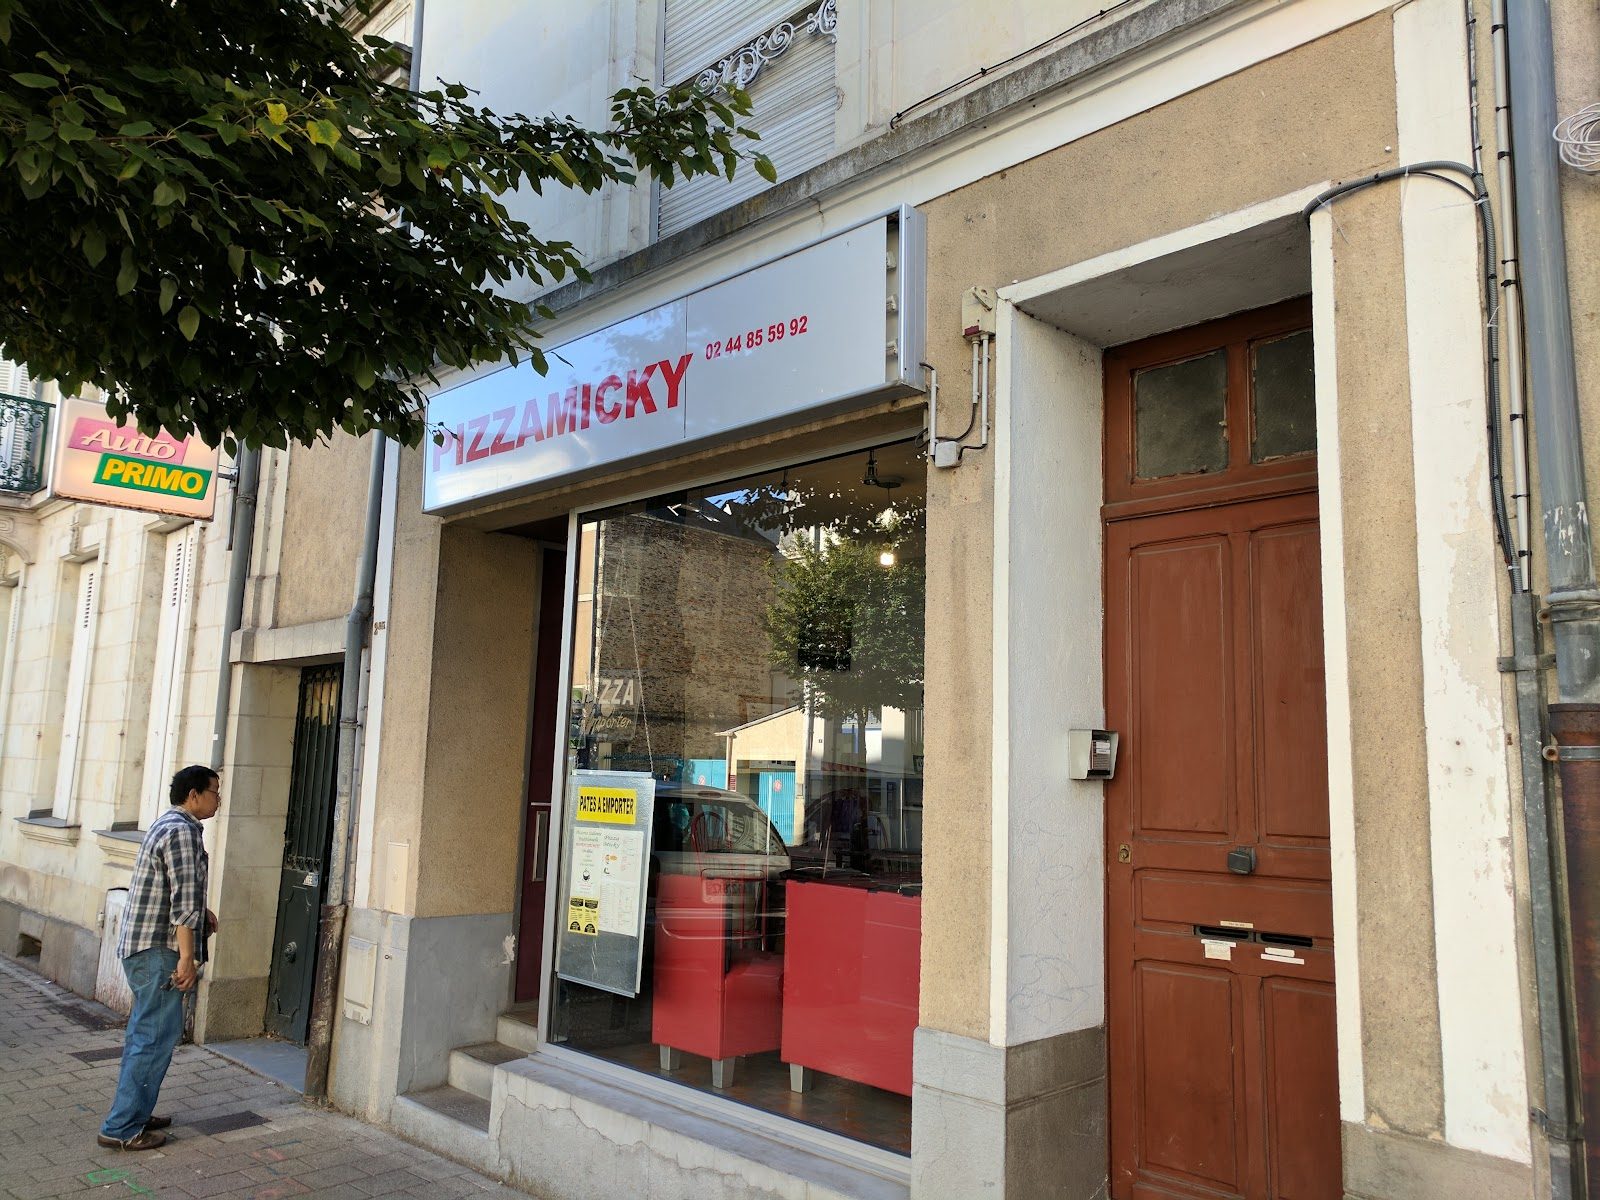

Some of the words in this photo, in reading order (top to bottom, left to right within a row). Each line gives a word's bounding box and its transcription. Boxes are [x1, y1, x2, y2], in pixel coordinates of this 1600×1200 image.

[705, 341, 721, 360] 02
[725, 335, 742, 354] 44
[746, 329, 763, 349] 85
[767, 322, 785, 343] 59
[789, 315, 808, 336] 92
[432, 353, 694, 472] PIZZAMICKY
[81, 429, 177, 460] Auto
[101, 458, 204, 494] PRIMO
[579, 796, 597, 812] PATES
[597, 797, 602, 813] A
[602, 796, 634, 815] EMPORTER
